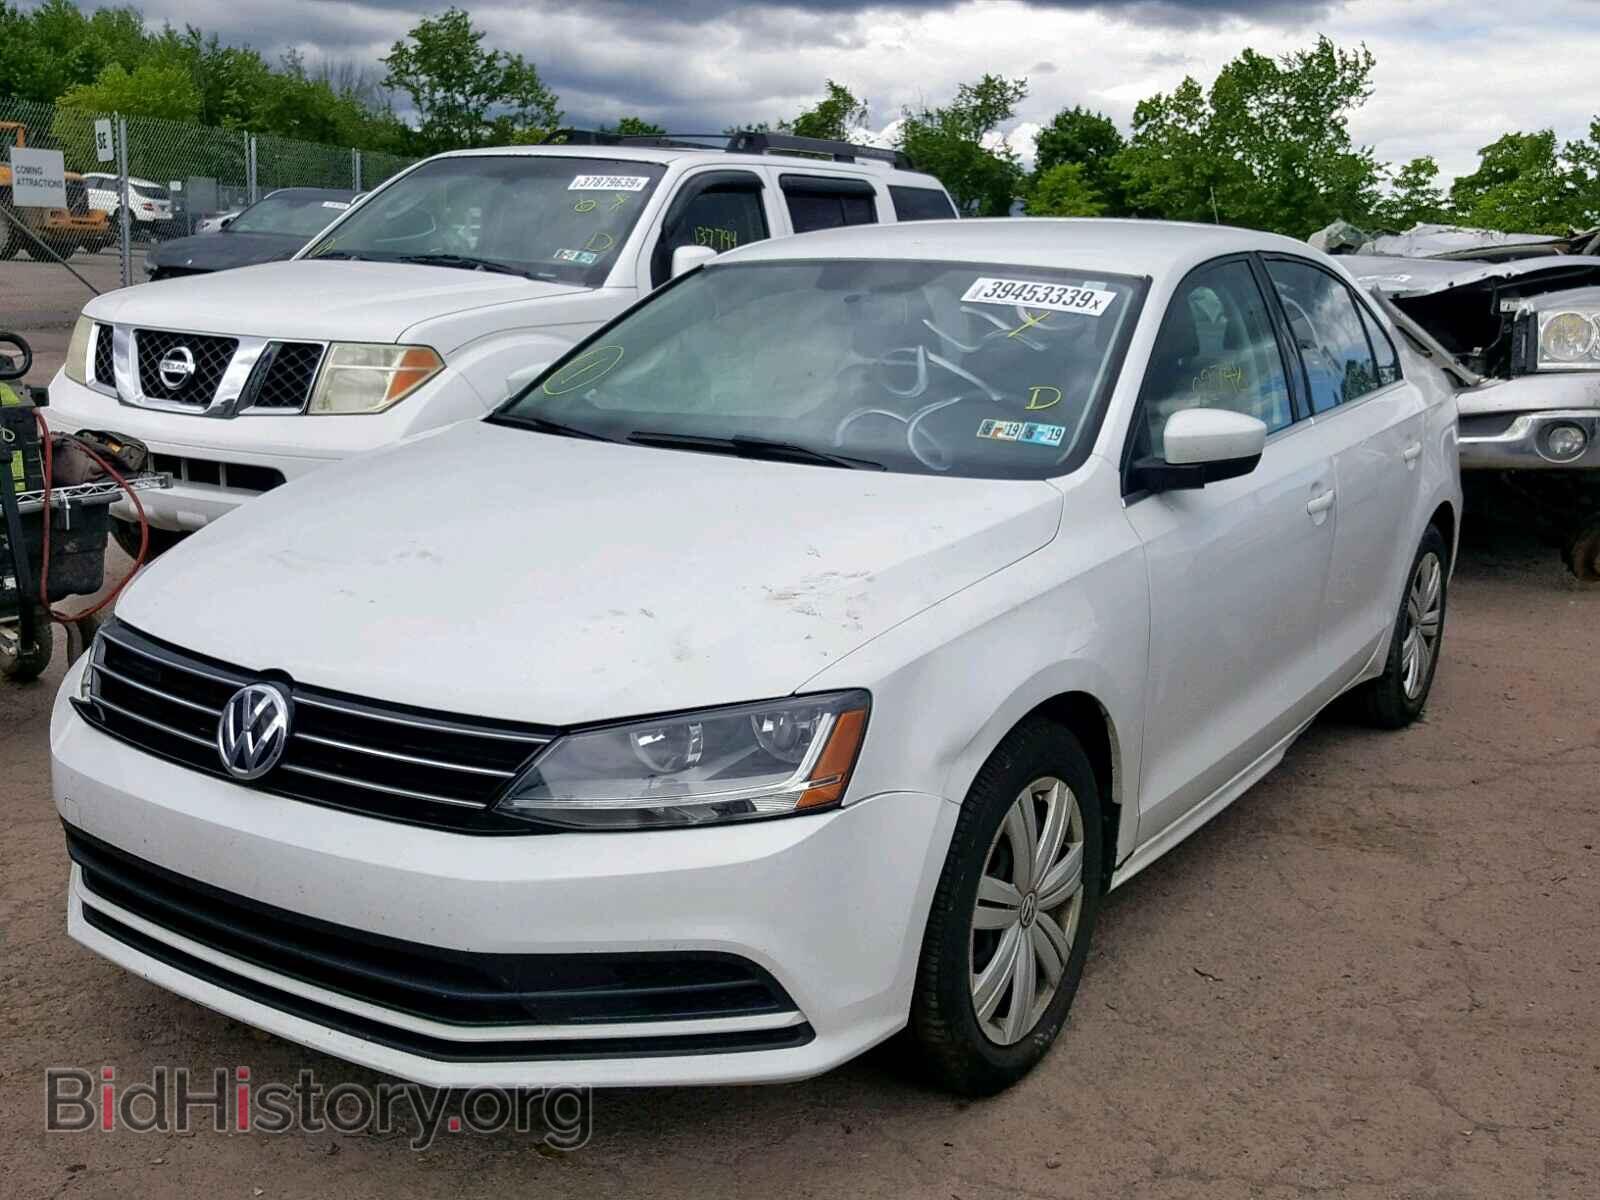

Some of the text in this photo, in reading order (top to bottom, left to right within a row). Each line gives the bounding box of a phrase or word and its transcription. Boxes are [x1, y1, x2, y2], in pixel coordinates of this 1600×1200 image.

[15, 165, 43, 176] COMING
[16, 177, 64, 189] ATTRACTIONS
[1024, 385, 1062, 411] D
